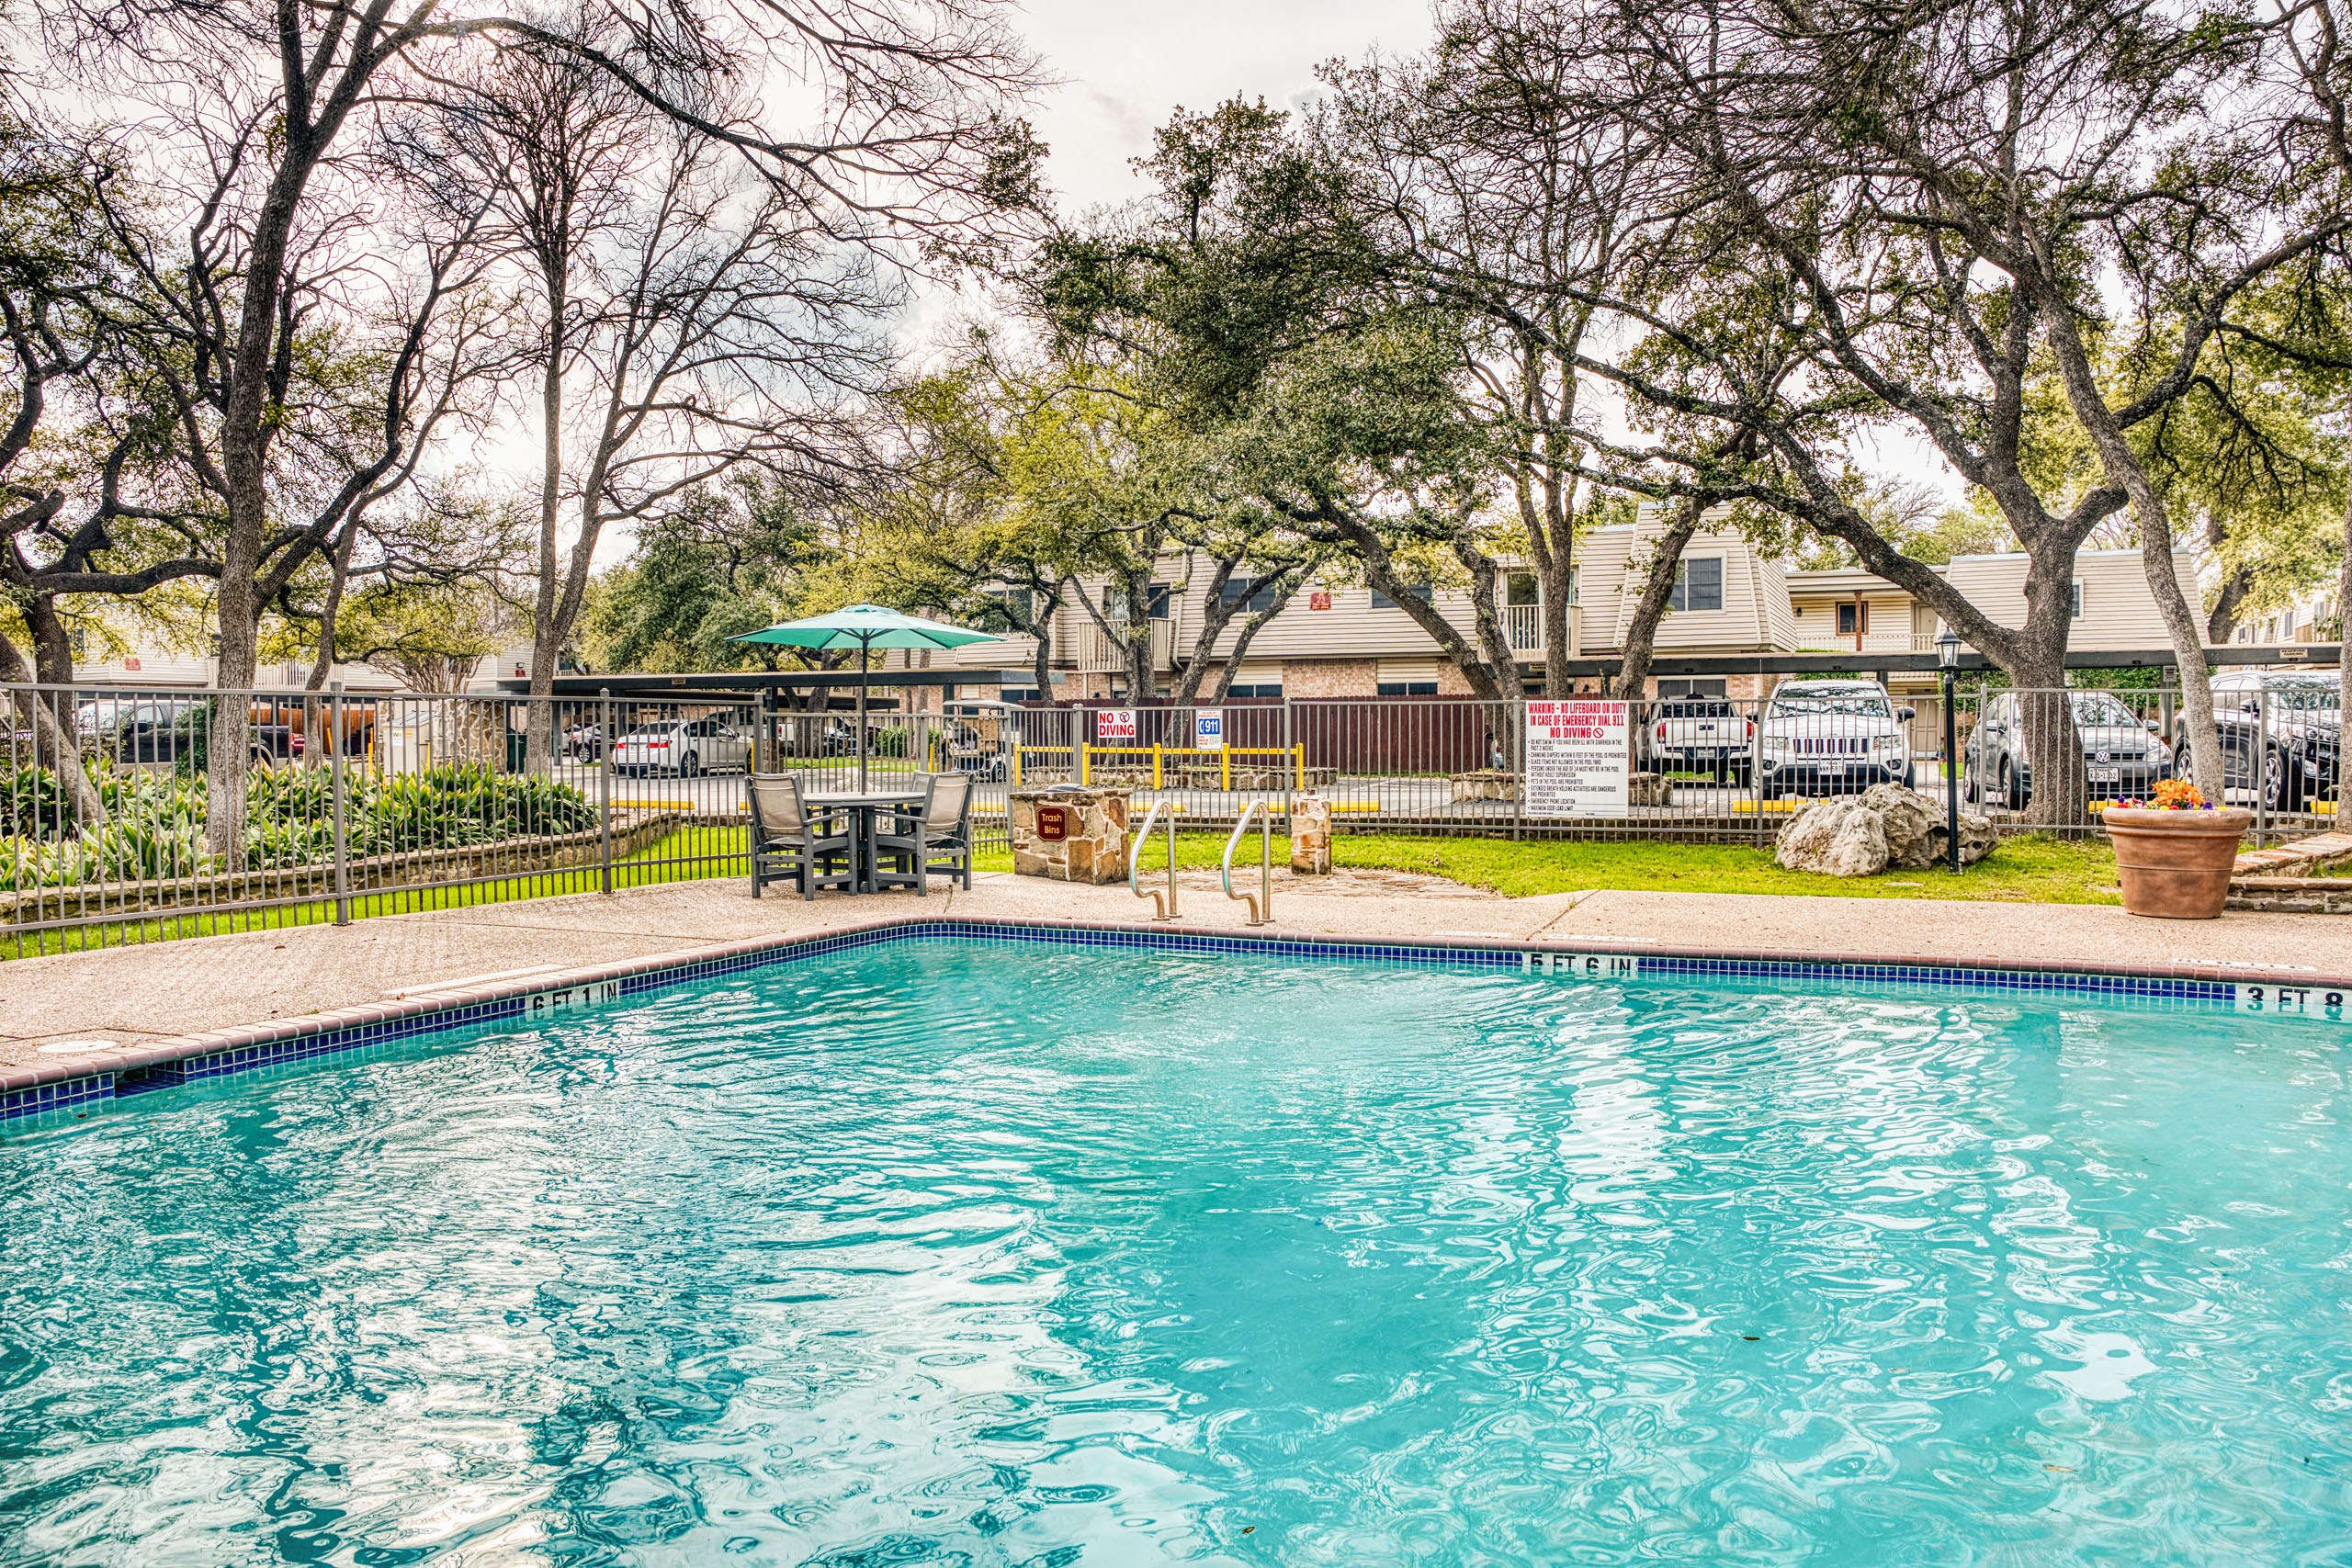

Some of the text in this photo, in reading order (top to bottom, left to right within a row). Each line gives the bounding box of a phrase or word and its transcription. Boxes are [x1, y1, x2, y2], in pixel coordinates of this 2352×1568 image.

[1529, 703, 1555, 713] WARNING
[1561, 703, 1568, 713] NO
[1570, 703, 1601, 713] LIFEGUARD
[1602, 703, 1609, 713] ON
[1611, 703, 1626, 713] DUTY
[1099, 713, 1114, 723] NO
[1530, 715, 1624, 726] IN CASE OF EMERGENCY DIAL 911
[1099, 725, 1134, 735] DIVING
[1205, 720, 1218, 732] 911
[1550, 727, 1591, 738] NO DIVING
[1042, 814, 1062, 822] Trash
[1044, 825, 1060, 834] Bins
[1530, 953, 1630, 971] 5 FT 6 IN
[533, 982, 616, 1010] 6 FT 1 IN
[2248, 986, 2264, 1001] 3
[2278, 988, 2310, 1004] FT
